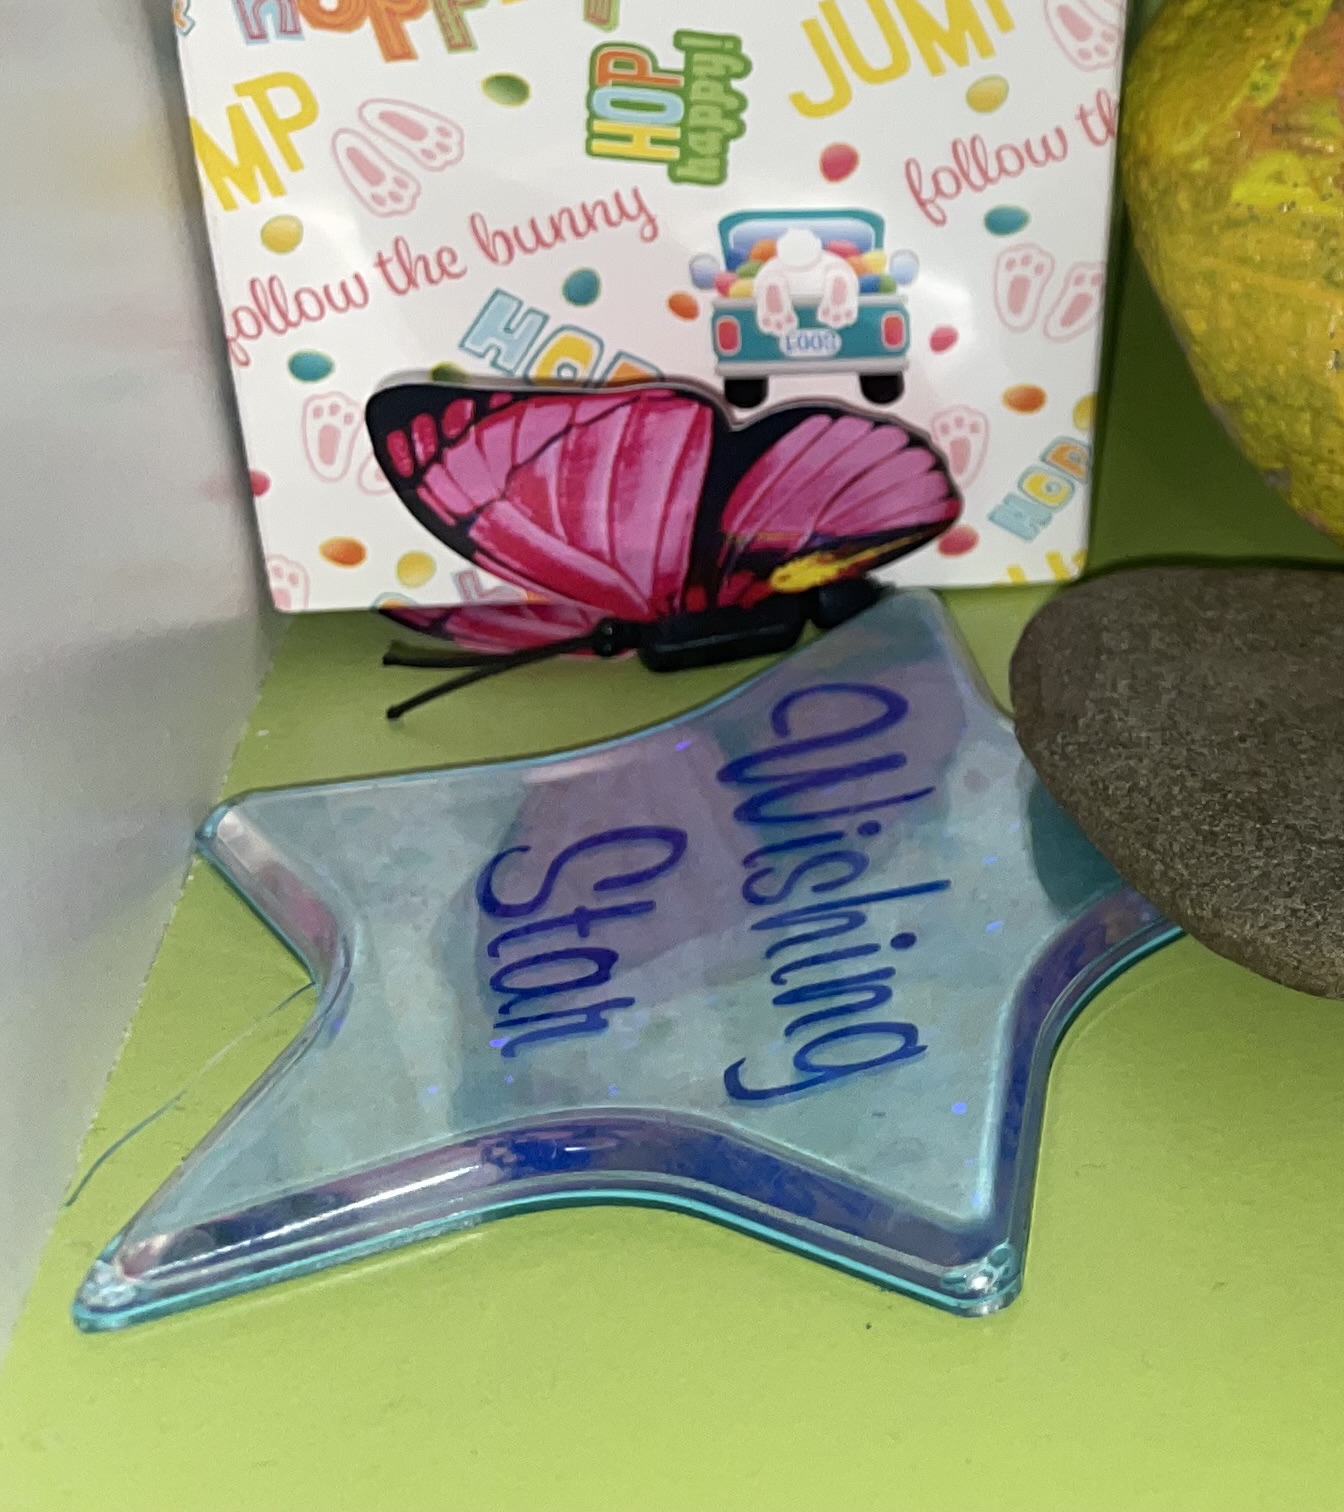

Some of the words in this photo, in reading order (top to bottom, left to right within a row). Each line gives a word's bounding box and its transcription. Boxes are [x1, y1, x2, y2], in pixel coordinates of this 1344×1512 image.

[590, 46, 686, 161] HOP
[904, 125, 1069, 228] follow
[373, 235, 468, 296] the
[469, 185, 660, 267] bunny
[476, 824, 688, 1059] Star
[715, 682, 952, 1102] Wishing
